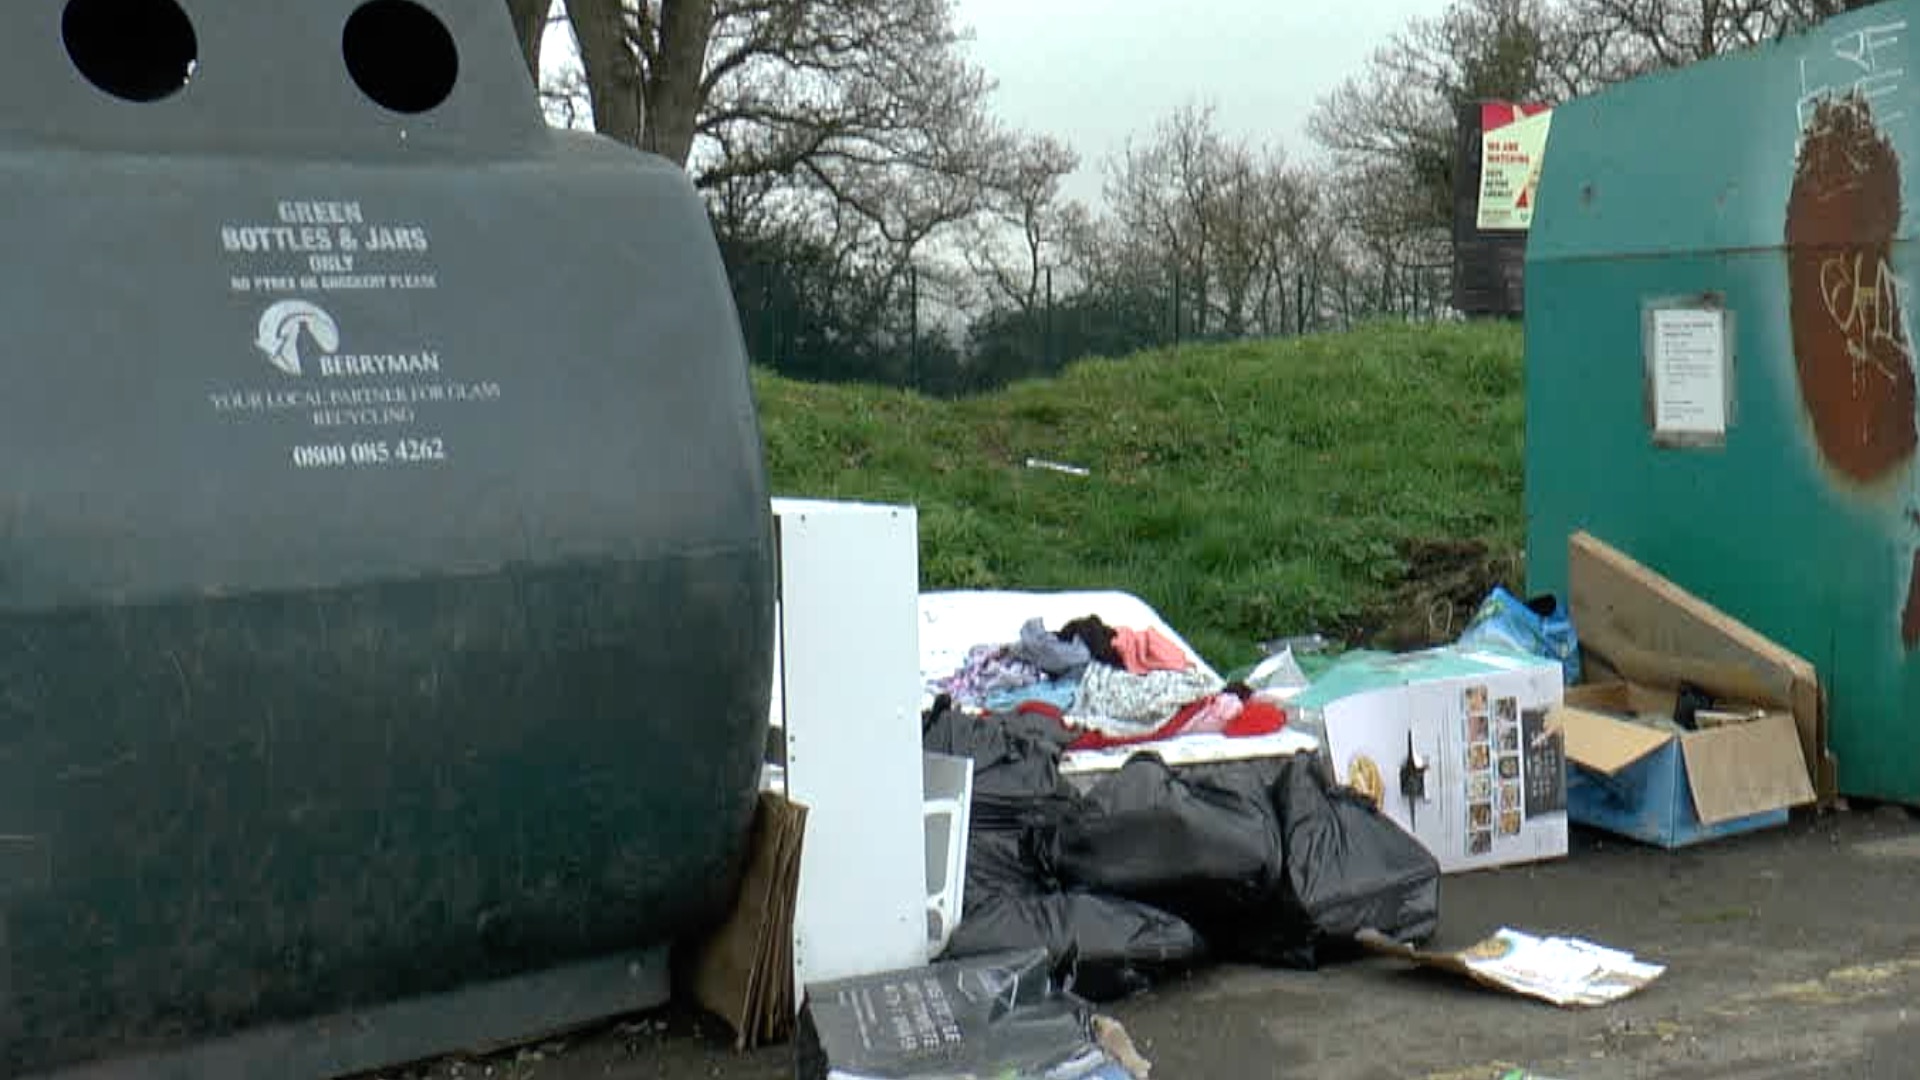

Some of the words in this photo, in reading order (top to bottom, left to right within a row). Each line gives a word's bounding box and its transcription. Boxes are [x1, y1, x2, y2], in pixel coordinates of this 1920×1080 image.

[278, 200, 364, 224] GREEN
[221, 226, 333, 251] BOTTLES
[339, 227, 358, 250] &
[365, 226, 428, 250] JARS
[309, 254, 353, 272] ONLY
[320, 352, 440, 376] BERRYMAN
[212, 391, 264, 410] YOUR
[266, 389, 322, 408] LOCAL
[330, 385, 407, 405] PARTNER
[409, 384, 444, 401] FOR
[447, 380, 501, 400] GLASS
[313, 406, 416, 425] RECYCLING
[292, 444, 347, 468] 0800
[350, 441, 390, 464] 085
[395, 437, 445, 461] 4262
